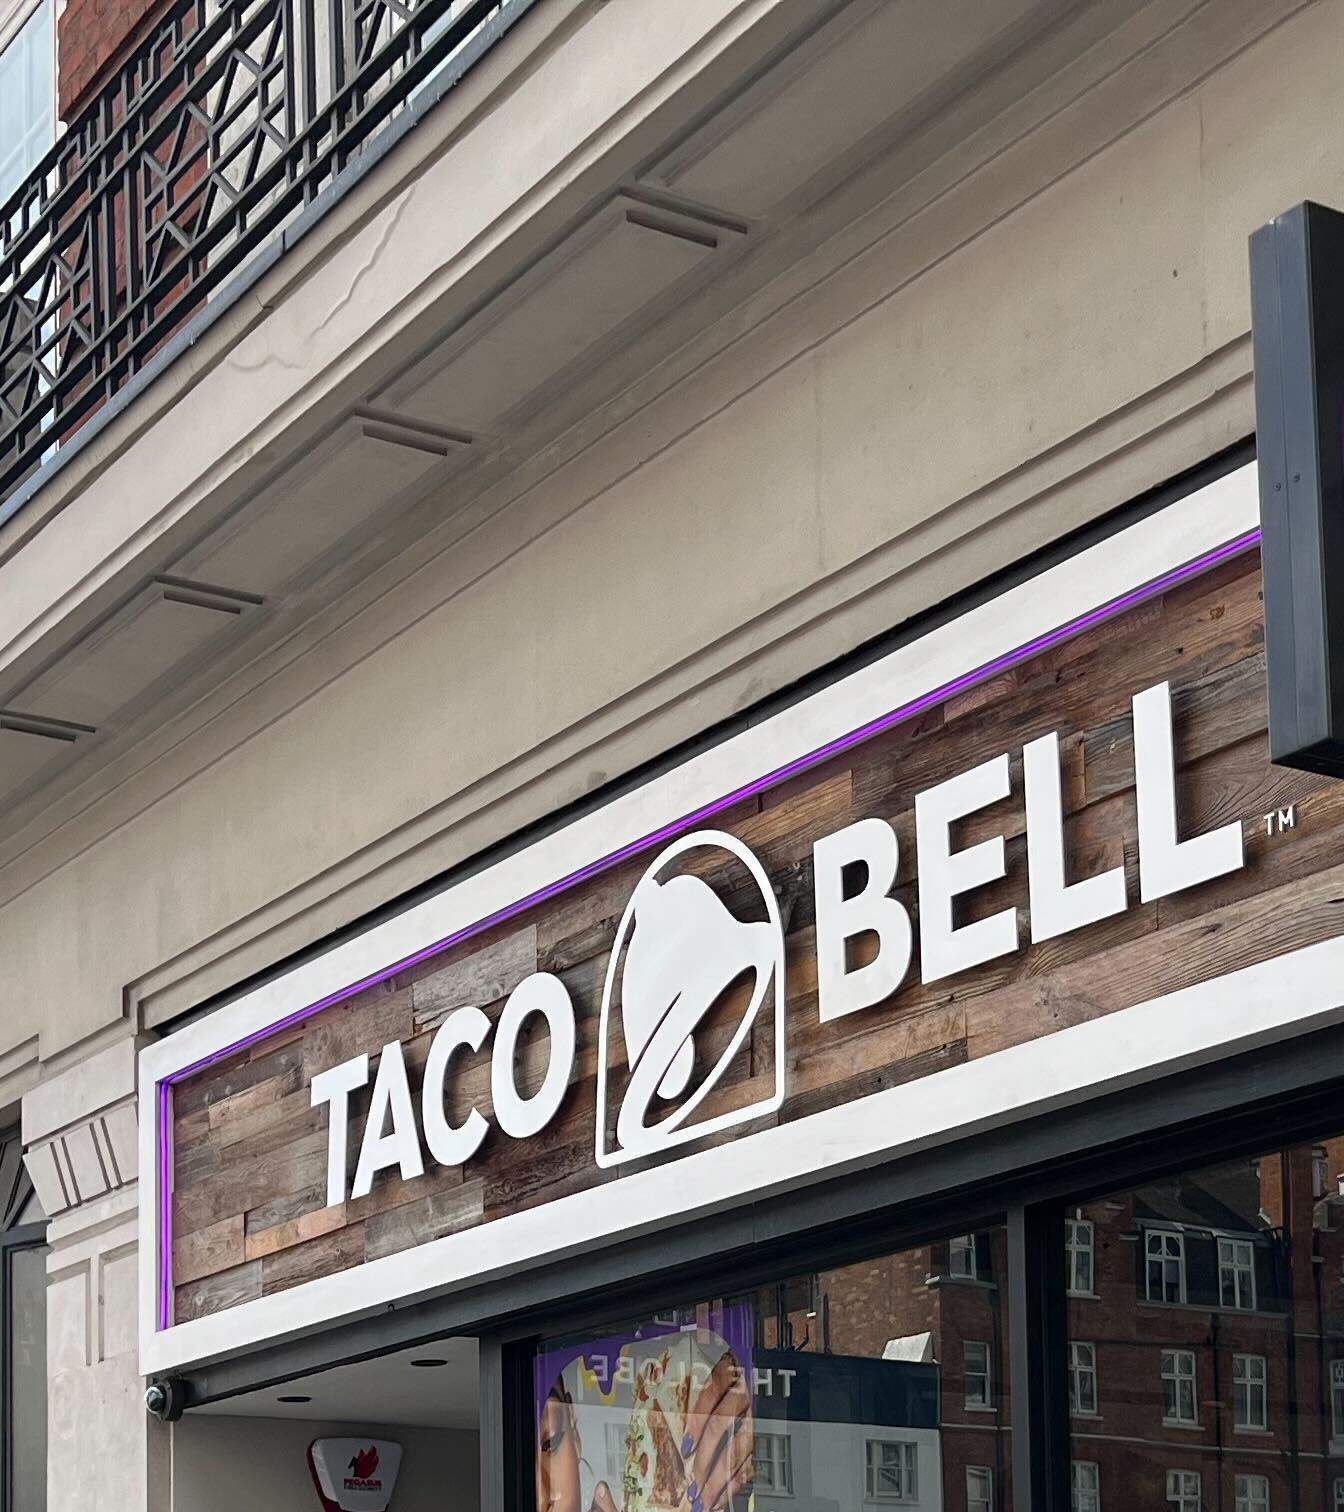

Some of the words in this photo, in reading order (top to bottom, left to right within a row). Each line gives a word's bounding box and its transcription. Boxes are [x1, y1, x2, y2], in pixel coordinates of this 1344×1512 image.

[309, 971, 576, 1206] TACO
[813, 680, 1245, 1023] BELL
[1264, 805, 1296, 837] TM
